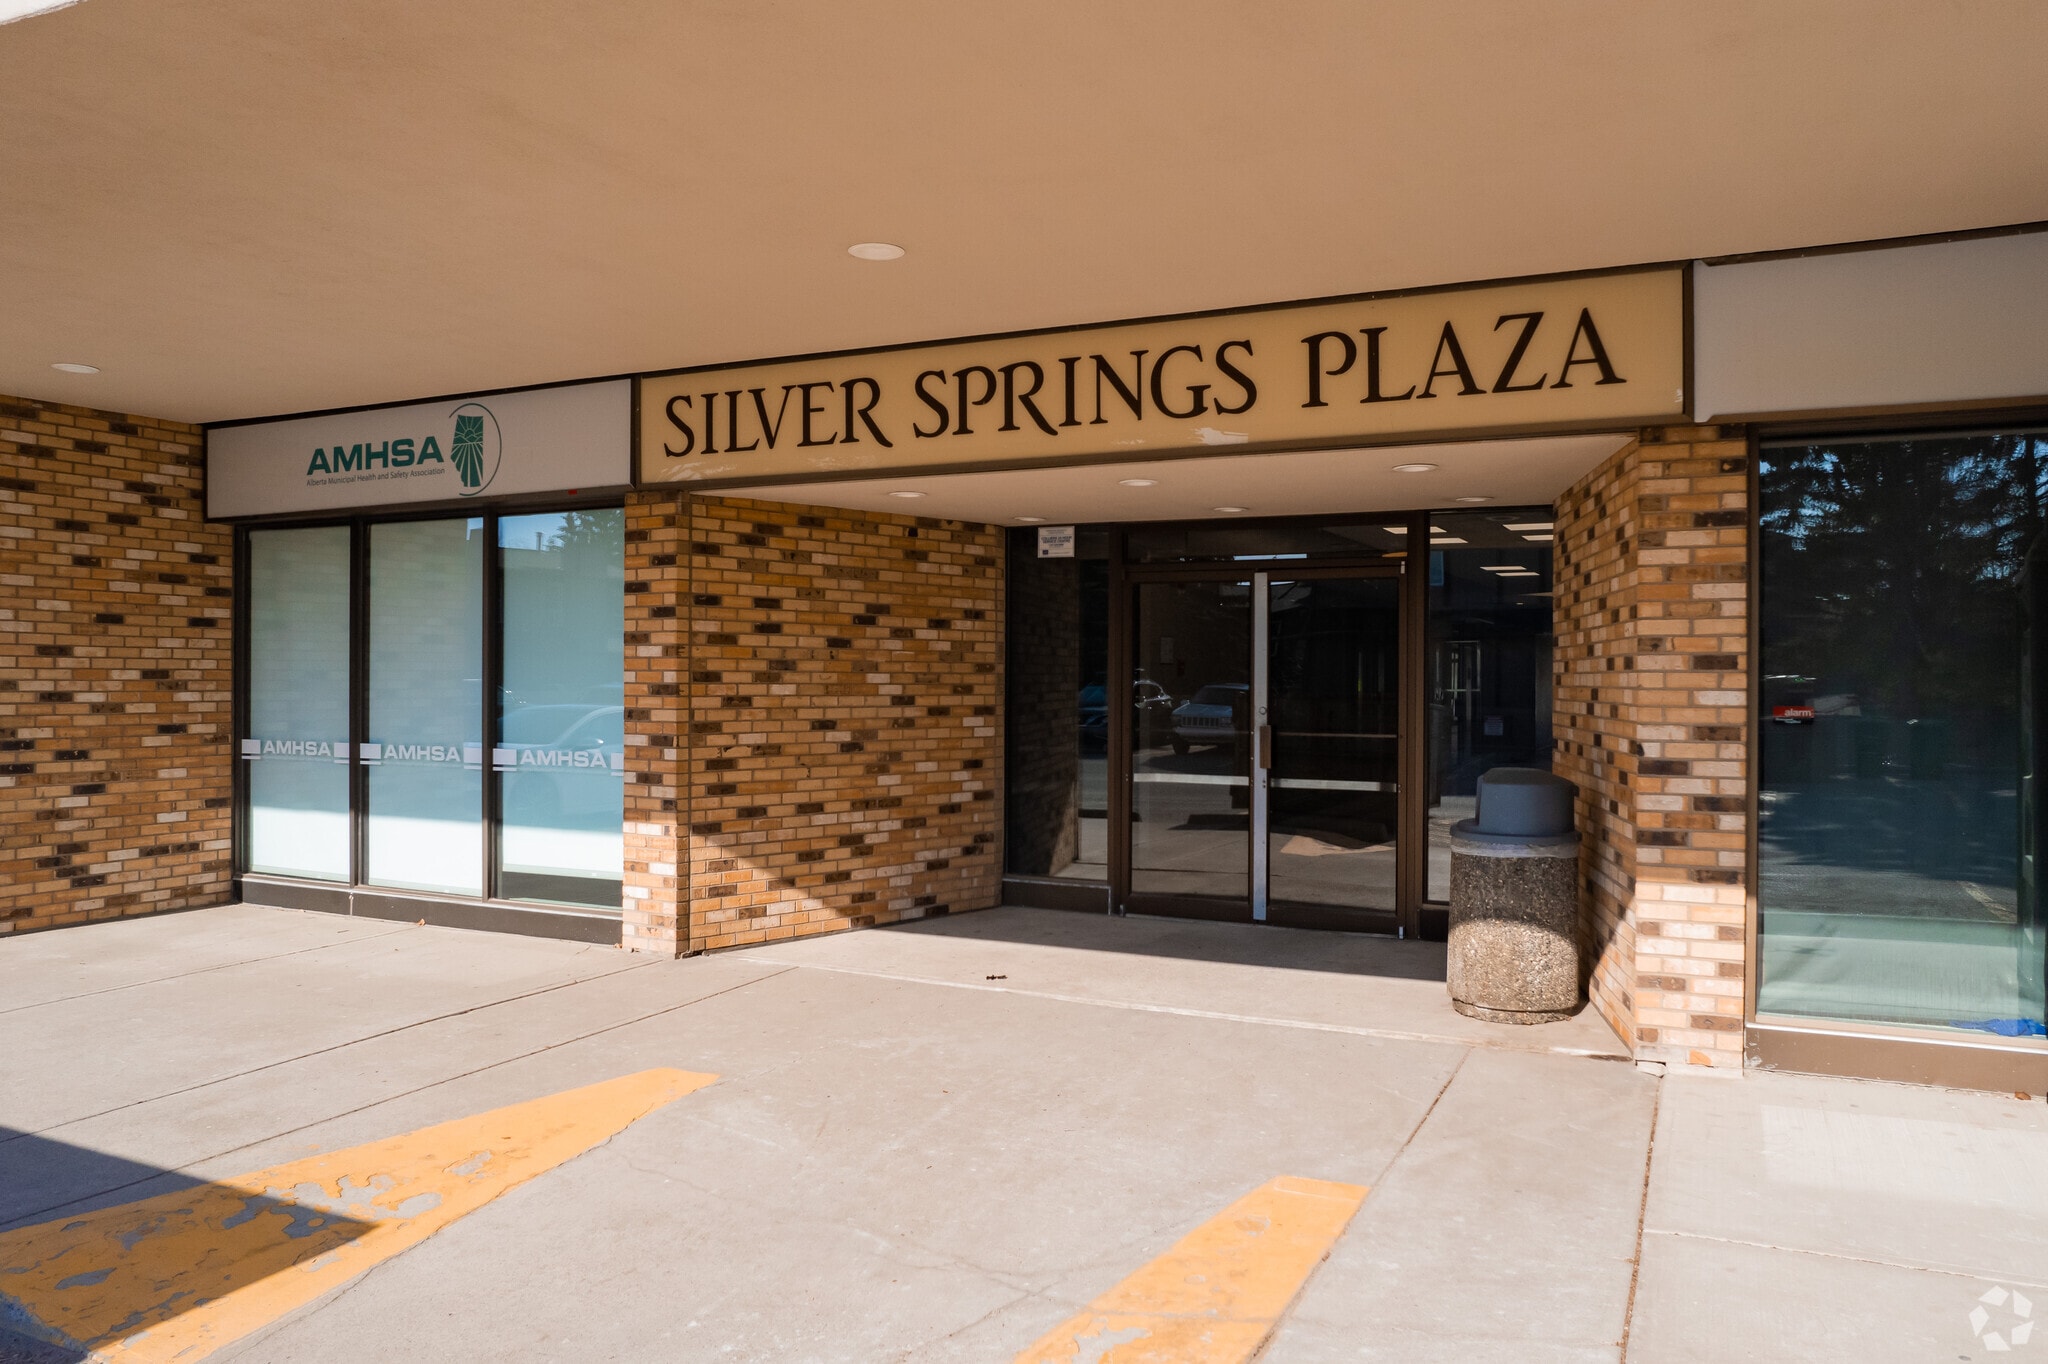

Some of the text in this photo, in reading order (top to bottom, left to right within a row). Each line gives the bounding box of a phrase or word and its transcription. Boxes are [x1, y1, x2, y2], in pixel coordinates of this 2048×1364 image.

[664, 307, 1627, 458] SILVER SPRINGS PLAZA
[307, 436, 444, 475] AMHSA
[306, 467, 445, 487] Alberta Municipal Health and Safety Association
[1784, 708, 1811, 717] alarm
[263, 740, 332, 757] AMHSA
[383, 744, 461, 762] AMHSA
[520, 749, 608, 769] AMHSA
